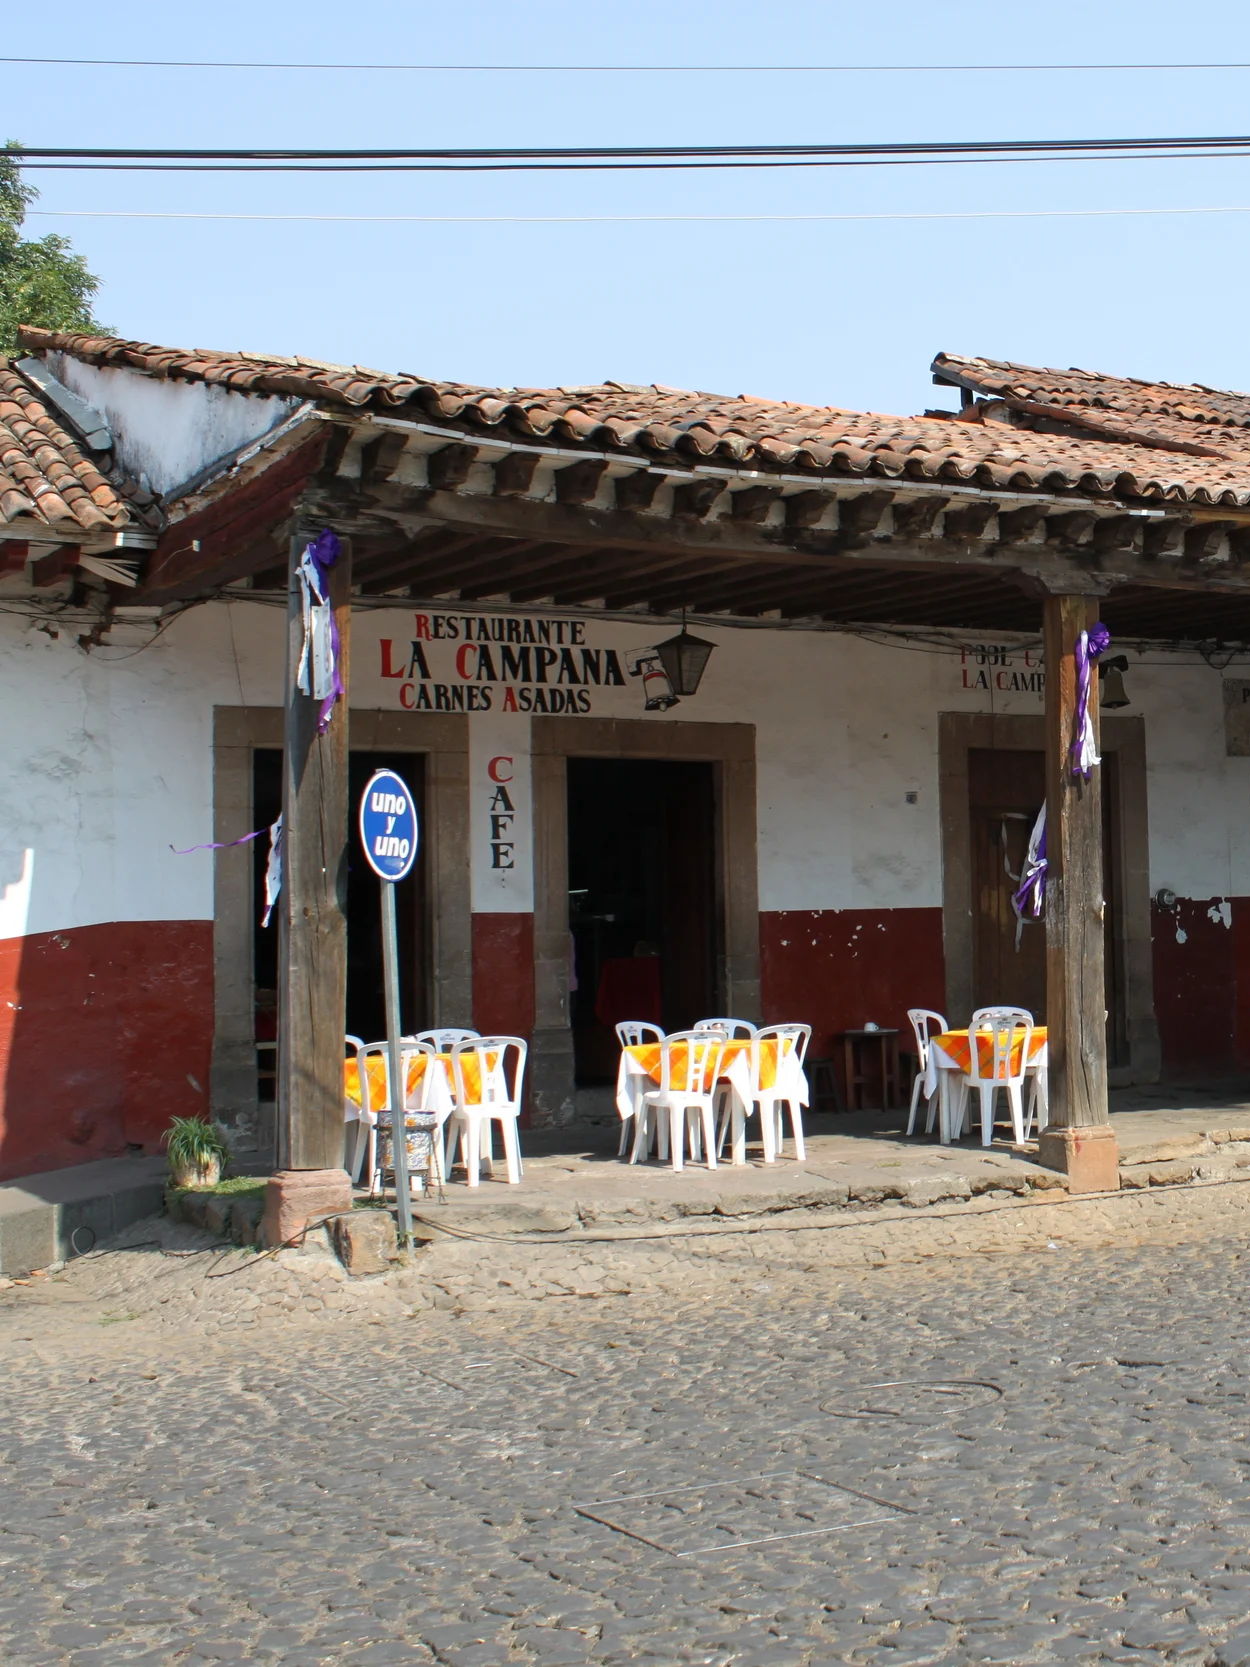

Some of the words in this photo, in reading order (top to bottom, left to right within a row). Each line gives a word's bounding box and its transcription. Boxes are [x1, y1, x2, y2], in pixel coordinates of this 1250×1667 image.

[414, 613, 586, 645] RESTAURANTE
[379, 638, 432, 680] LA
[455, 643, 627, 686] CAMPANA
[962, 669, 990, 690] LA
[996, 671, 1046, 692] CAMP
[399, 682, 493, 711] CARNES
[502, 686, 592, 714] ASADAS
[372, 792, 407, 816] uno
[386, 816, 396, 834] y
[375, 835, 410, 859] uno
